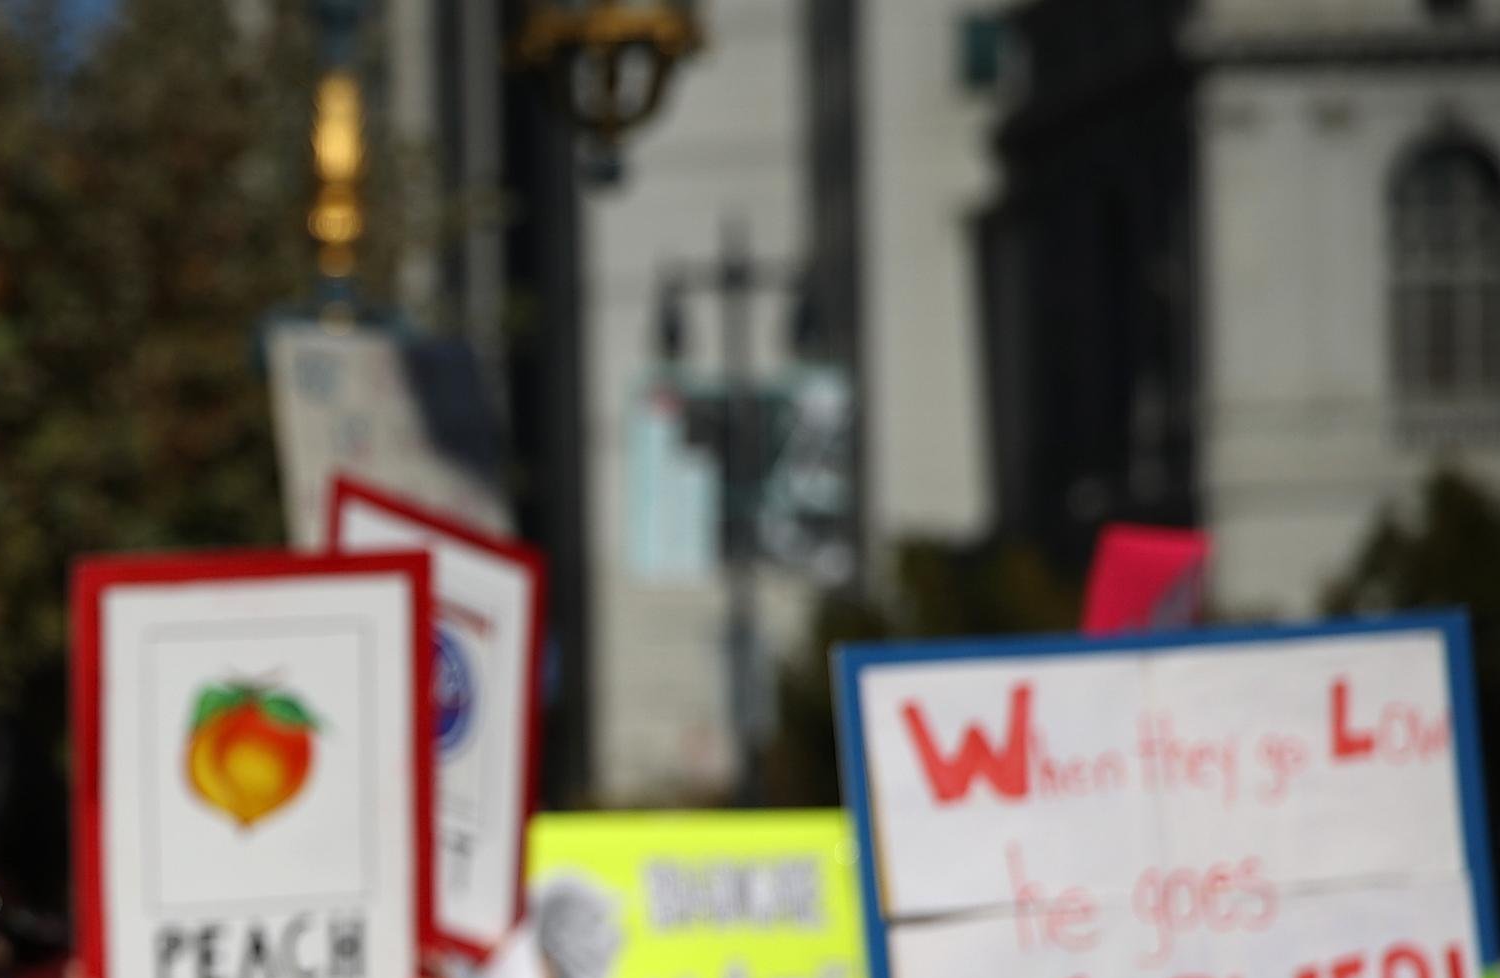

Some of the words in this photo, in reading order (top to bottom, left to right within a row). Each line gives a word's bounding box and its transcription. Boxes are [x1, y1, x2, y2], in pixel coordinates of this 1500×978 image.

[1134, 708, 1240, 806] they
[1254, 734, 1309, 803] go
[1006, 840, 1102, 953] he
[1131, 857, 1280, 970] goes
